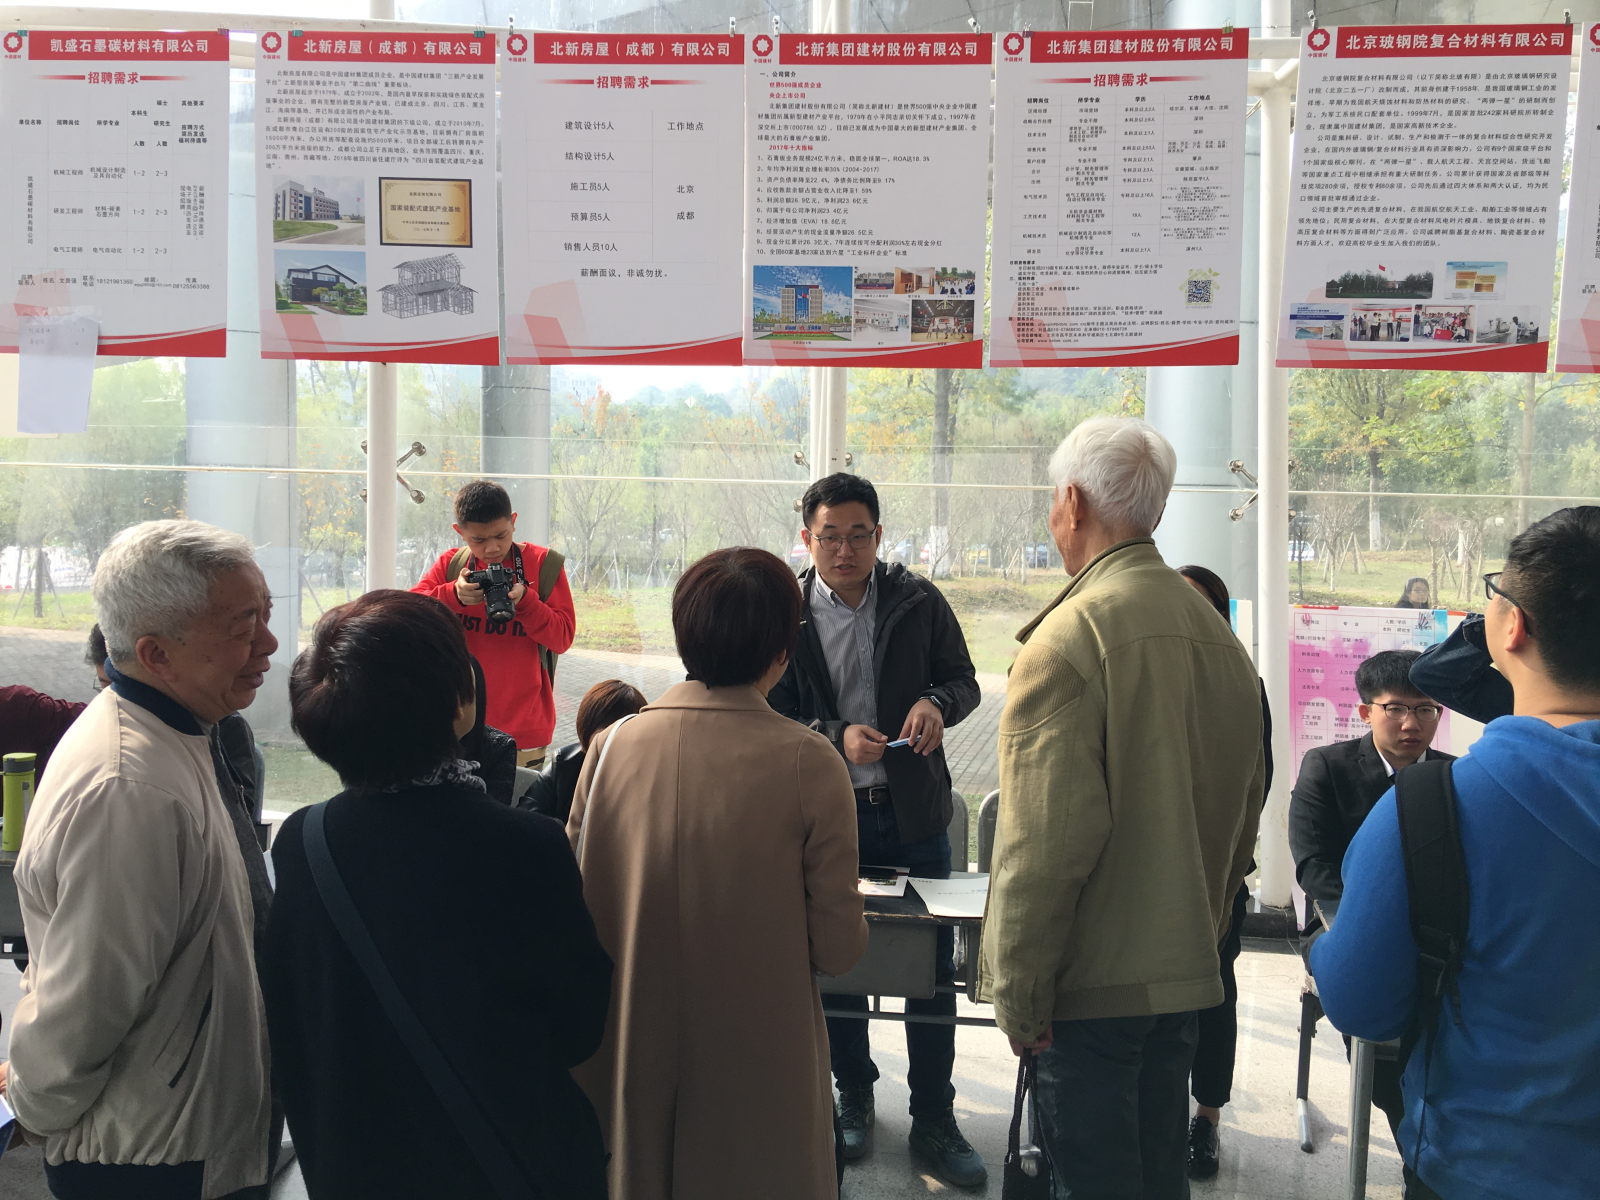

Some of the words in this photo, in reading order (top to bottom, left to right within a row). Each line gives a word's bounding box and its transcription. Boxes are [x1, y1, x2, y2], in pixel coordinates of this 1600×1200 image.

[51, 39, 208, 53] 凯盛石墨碳材料有限公司
[1047, 37, 1233, 54] 北新集团建材股份有限公司
[1346, 33, 1564, 49] 北京玻钢院复合材料有限公司
[304, 40, 481, 55] 北新房屋（成都）有限公司
[550, 42, 729, 56] 北新房屋（成都）有限公司
[796, 42, 977, 56] 北新集团建材股份有限公司
[88, 72, 139, 84] 招聘需求
[597, 76, 649, 89] 招聘需求
[1094, 73, 1148, 87] 招聘需求
[565, 121, 614, 130] 建筑设计5人
[668, 122, 703, 130] 工作地点
[565, 152, 614, 160] 结构设计5人
[570, 182, 610, 191] 施工员5人
[677, 185, 694, 193] 北京
[571, 213, 610, 221] 预算员5人
[677, 211, 694, 220] 成都
[564, 243, 618, 251] 销售人员10人
[581, 269, 667, 277] 薪酬面议，非诚勿扰。
[485, 620, 507, 635] DO
